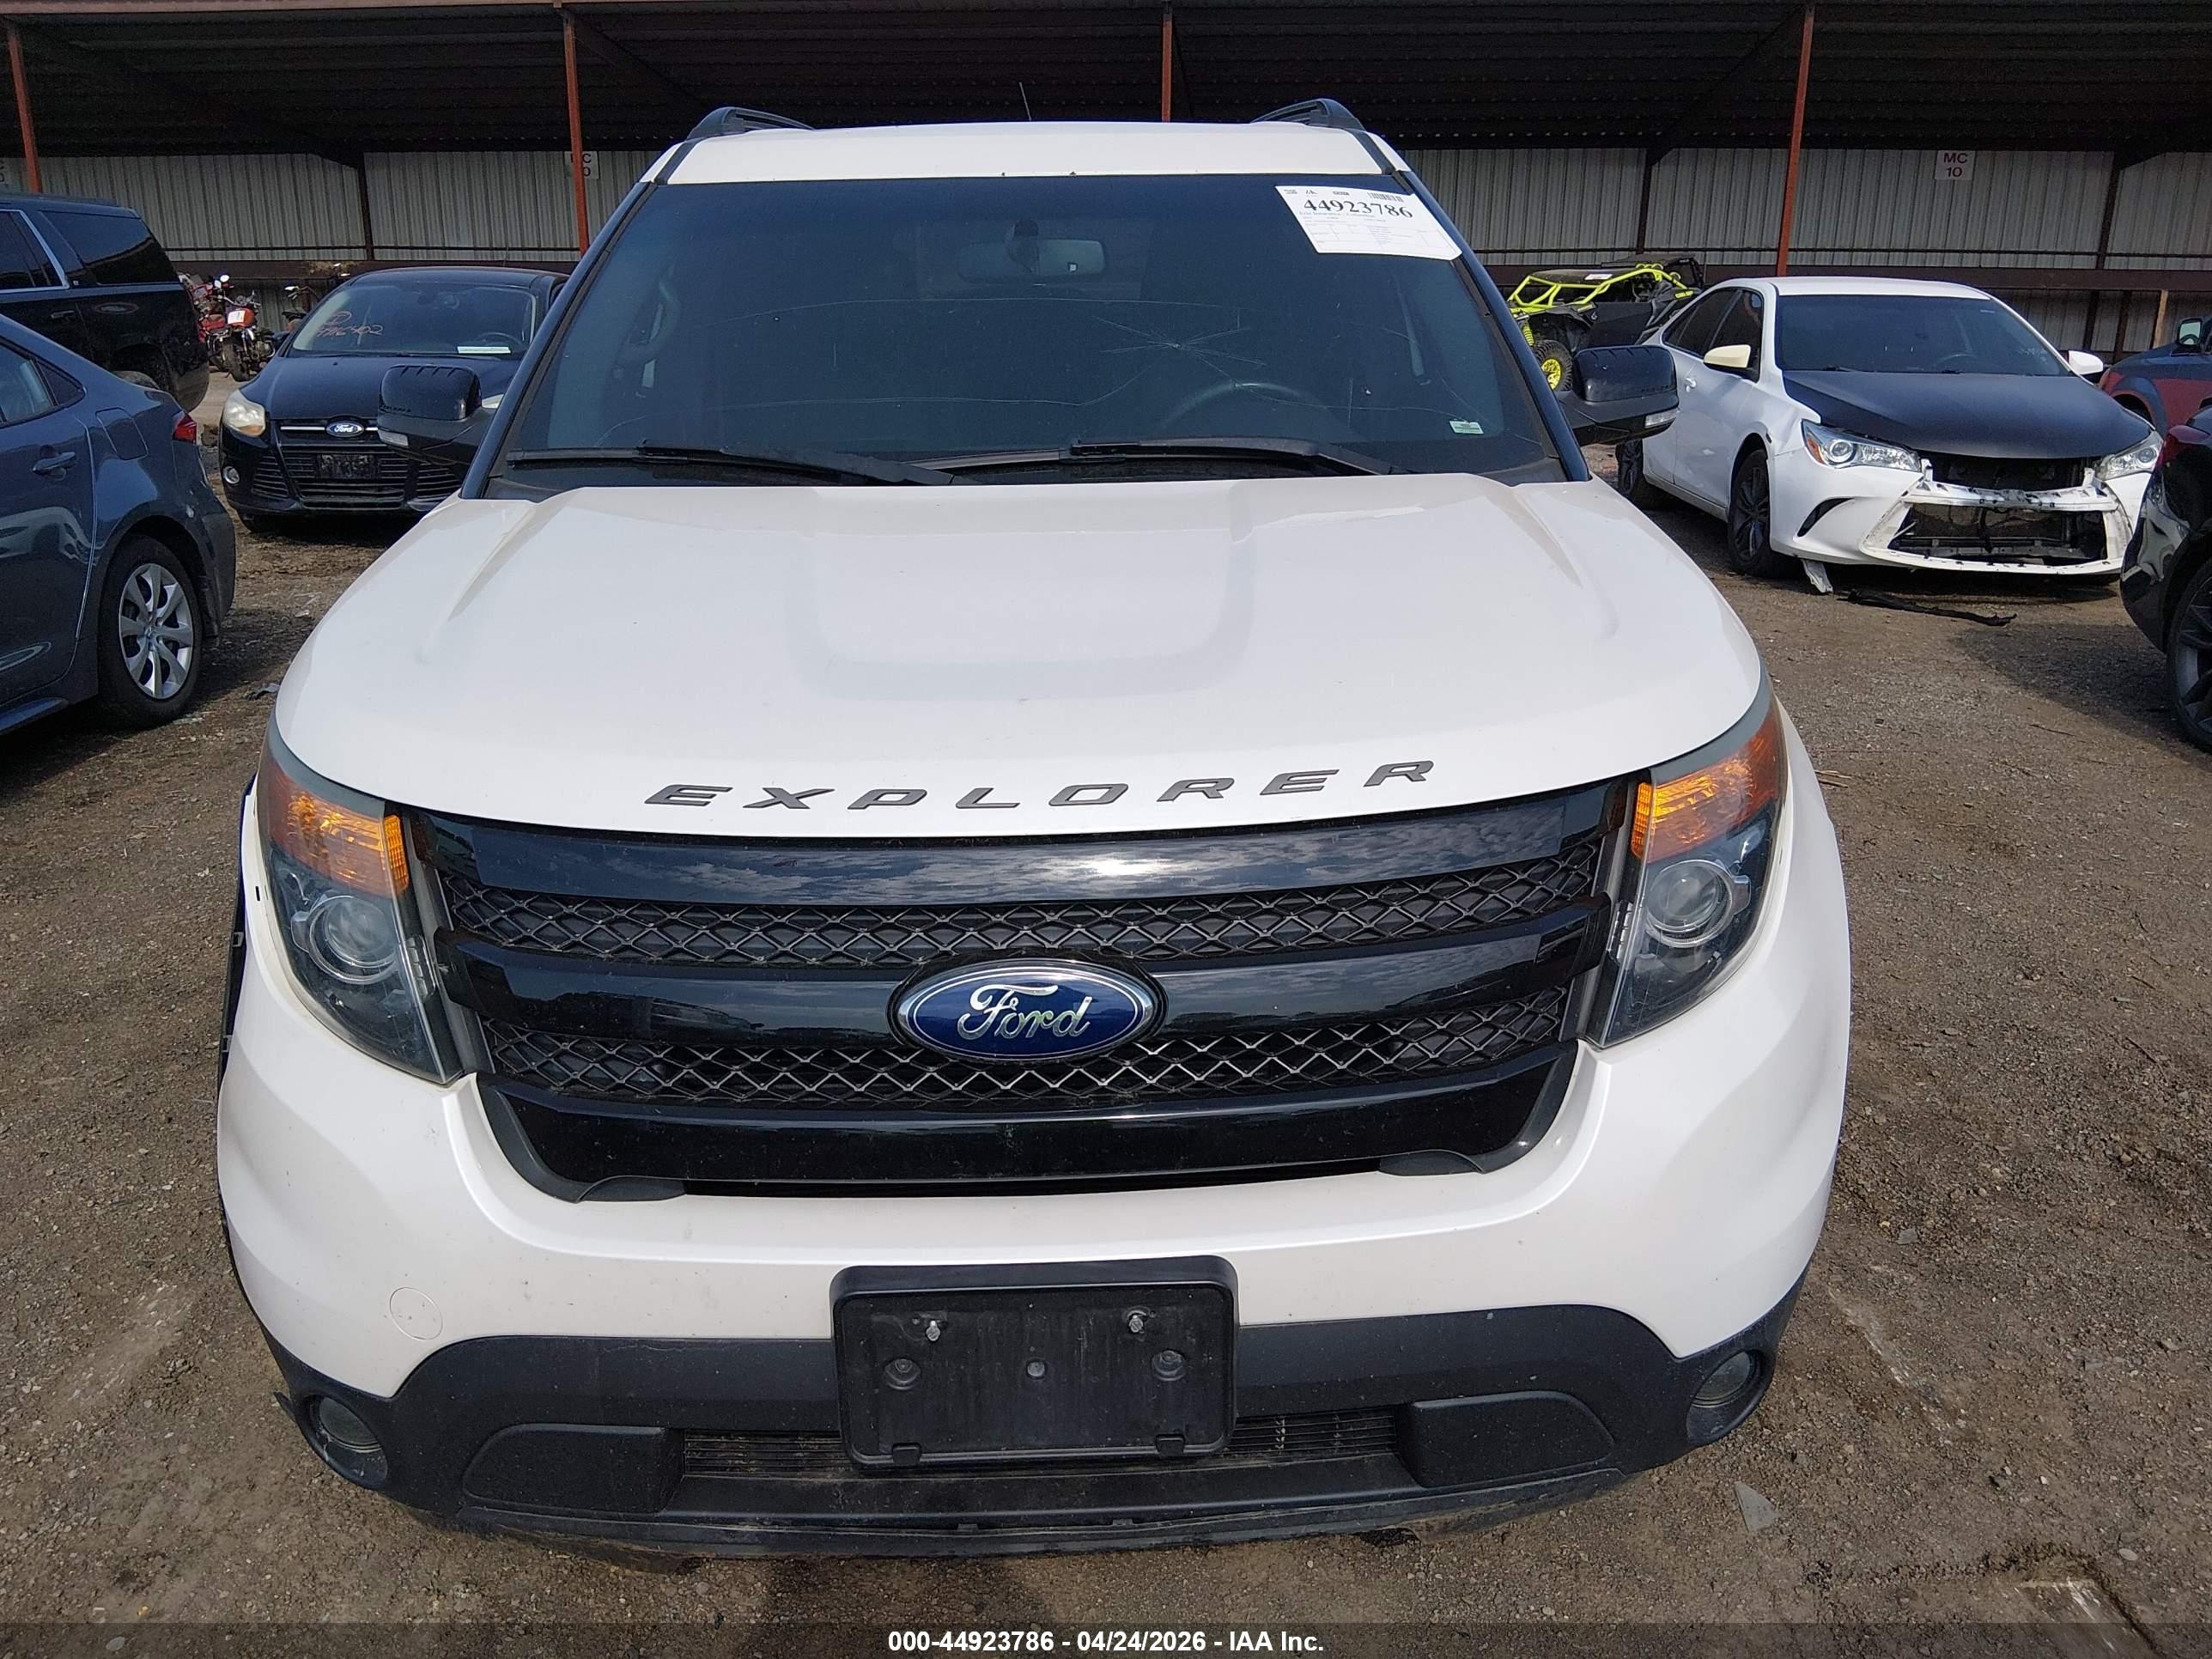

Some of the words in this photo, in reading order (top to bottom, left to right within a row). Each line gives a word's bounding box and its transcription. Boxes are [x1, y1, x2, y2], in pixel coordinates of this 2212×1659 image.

[1943, 152, 1968, 163] MC
[1946, 167, 1963, 178] 10
[1304, 199, 1413, 218] 44923786
[334, 424, 354, 433] Ford
[643, 760, 1435, 810] EXPLORER
[957, 983, 1093, 1040] Ford
